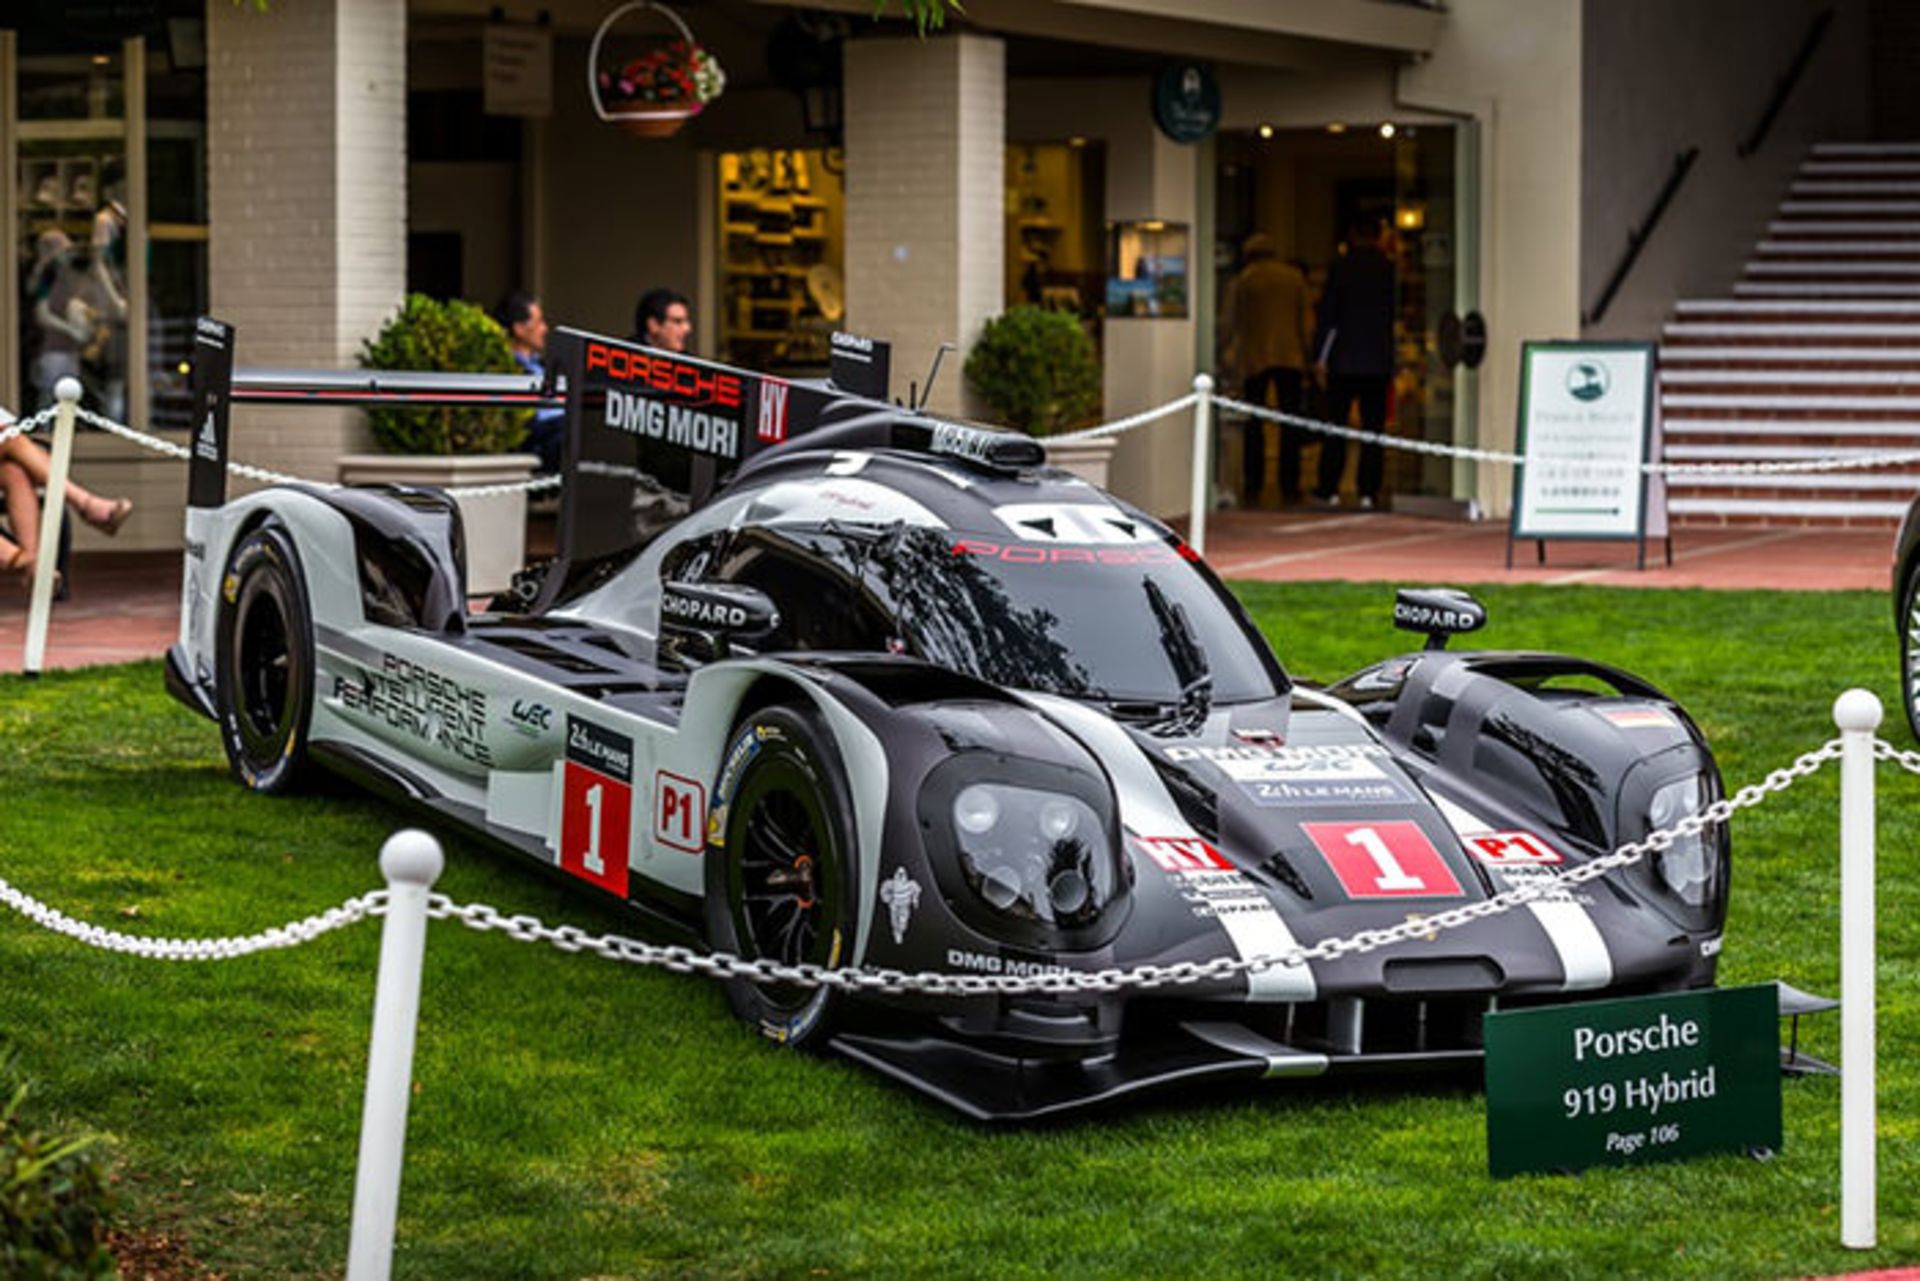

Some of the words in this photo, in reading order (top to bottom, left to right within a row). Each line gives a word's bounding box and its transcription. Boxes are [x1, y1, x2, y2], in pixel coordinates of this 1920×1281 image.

[587, 343, 741, 408] PORSCHE
[605, 387, 664, 439] DMG
[666, 404, 739, 460] MORI
[758, 380, 789, 440] HY
[662, 593, 747, 627] CHOPARD
[383, 652, 486, 717] PORSCHE
[583, 783, 605, 876] 1
[662, 785, 692, 840] P1
[1344, 827, 1426, 890] 1
[1472, 836, 1544, 858] P1
[947, 949, 1001, 972] DMG
[1574, 1013, 1699, 1061] Porsche
[1563, 1083, 1616, 1118] 919
[1625, 1065, 1716, 1115] Hybrid
[1606, 1131, 1646, 1154] Page
[1650, 1124, 1679, 1144] 106
